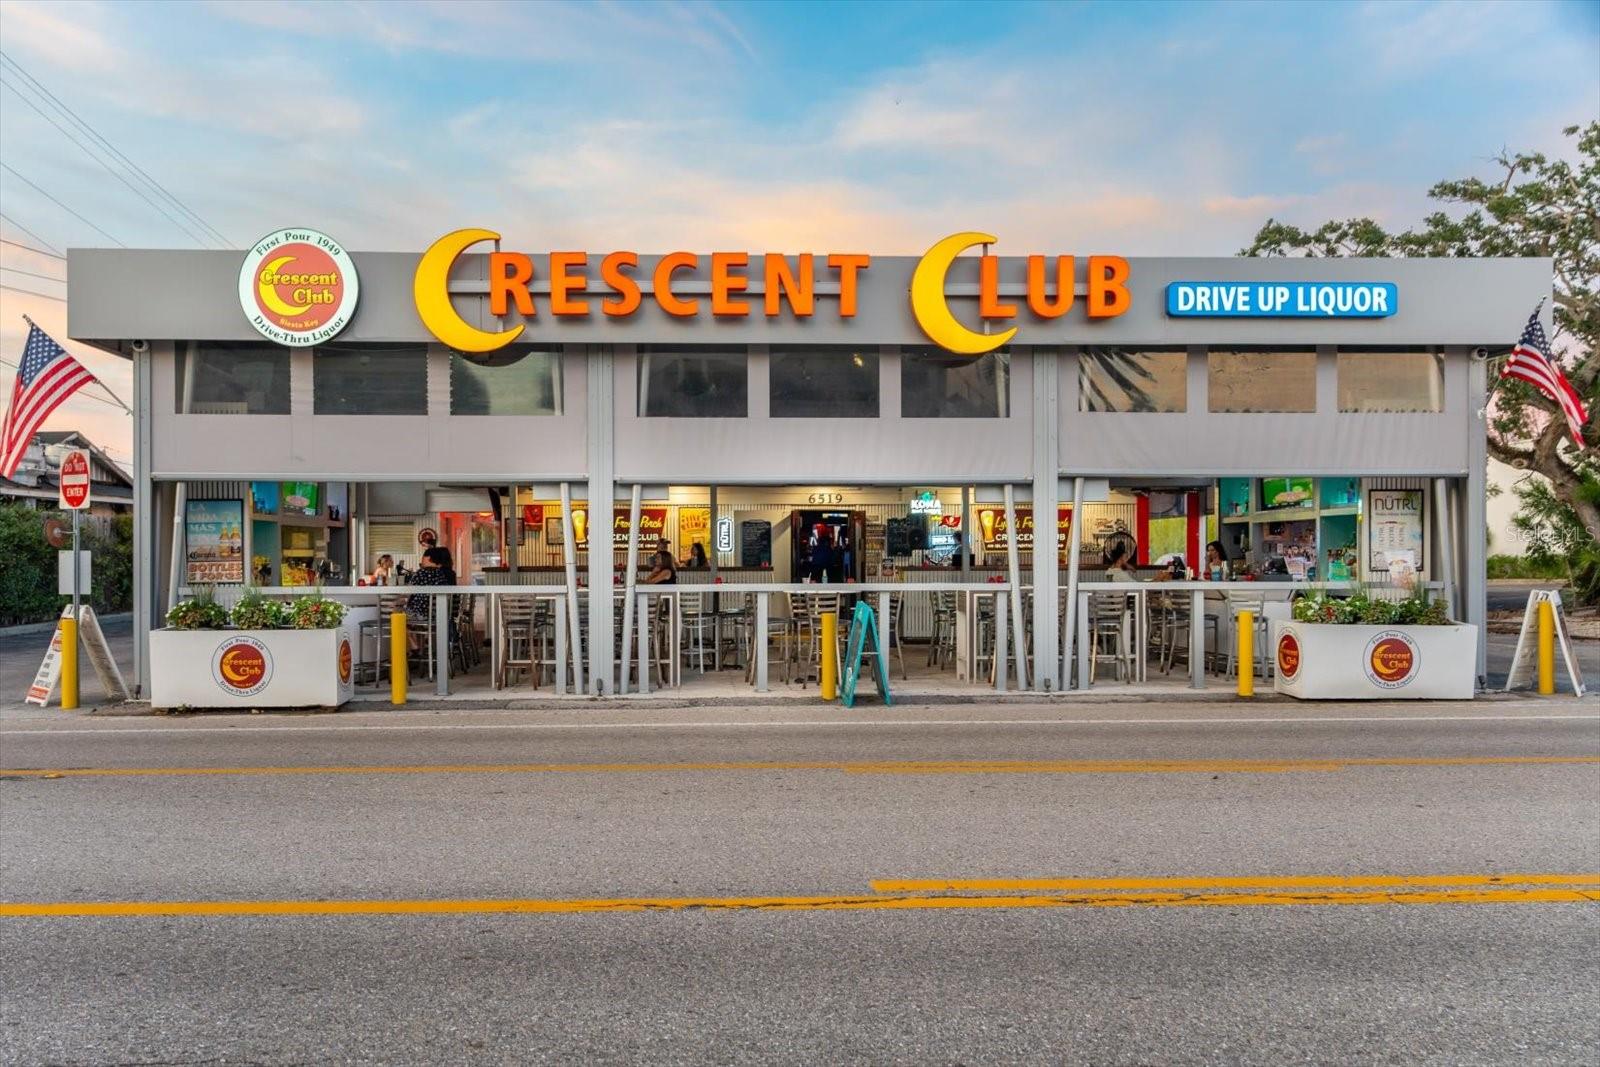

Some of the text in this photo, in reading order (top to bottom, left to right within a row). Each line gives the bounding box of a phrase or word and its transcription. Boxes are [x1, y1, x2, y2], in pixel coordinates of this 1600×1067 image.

[255, 232, 341, 257] First Pour 1949
[260, 269, 338, 285] Crescent
[292, 288, 335, 304] Club
[1177, 286, 1388, 315] DRIVE UP LIQUOR
[253, 315, 344, 343] Drive-Thru Liquor
[64, 462, 85, 472] DO NOT
[66, 487, 84, 497] ENTER
[808, 493, 843, 504] 6519
